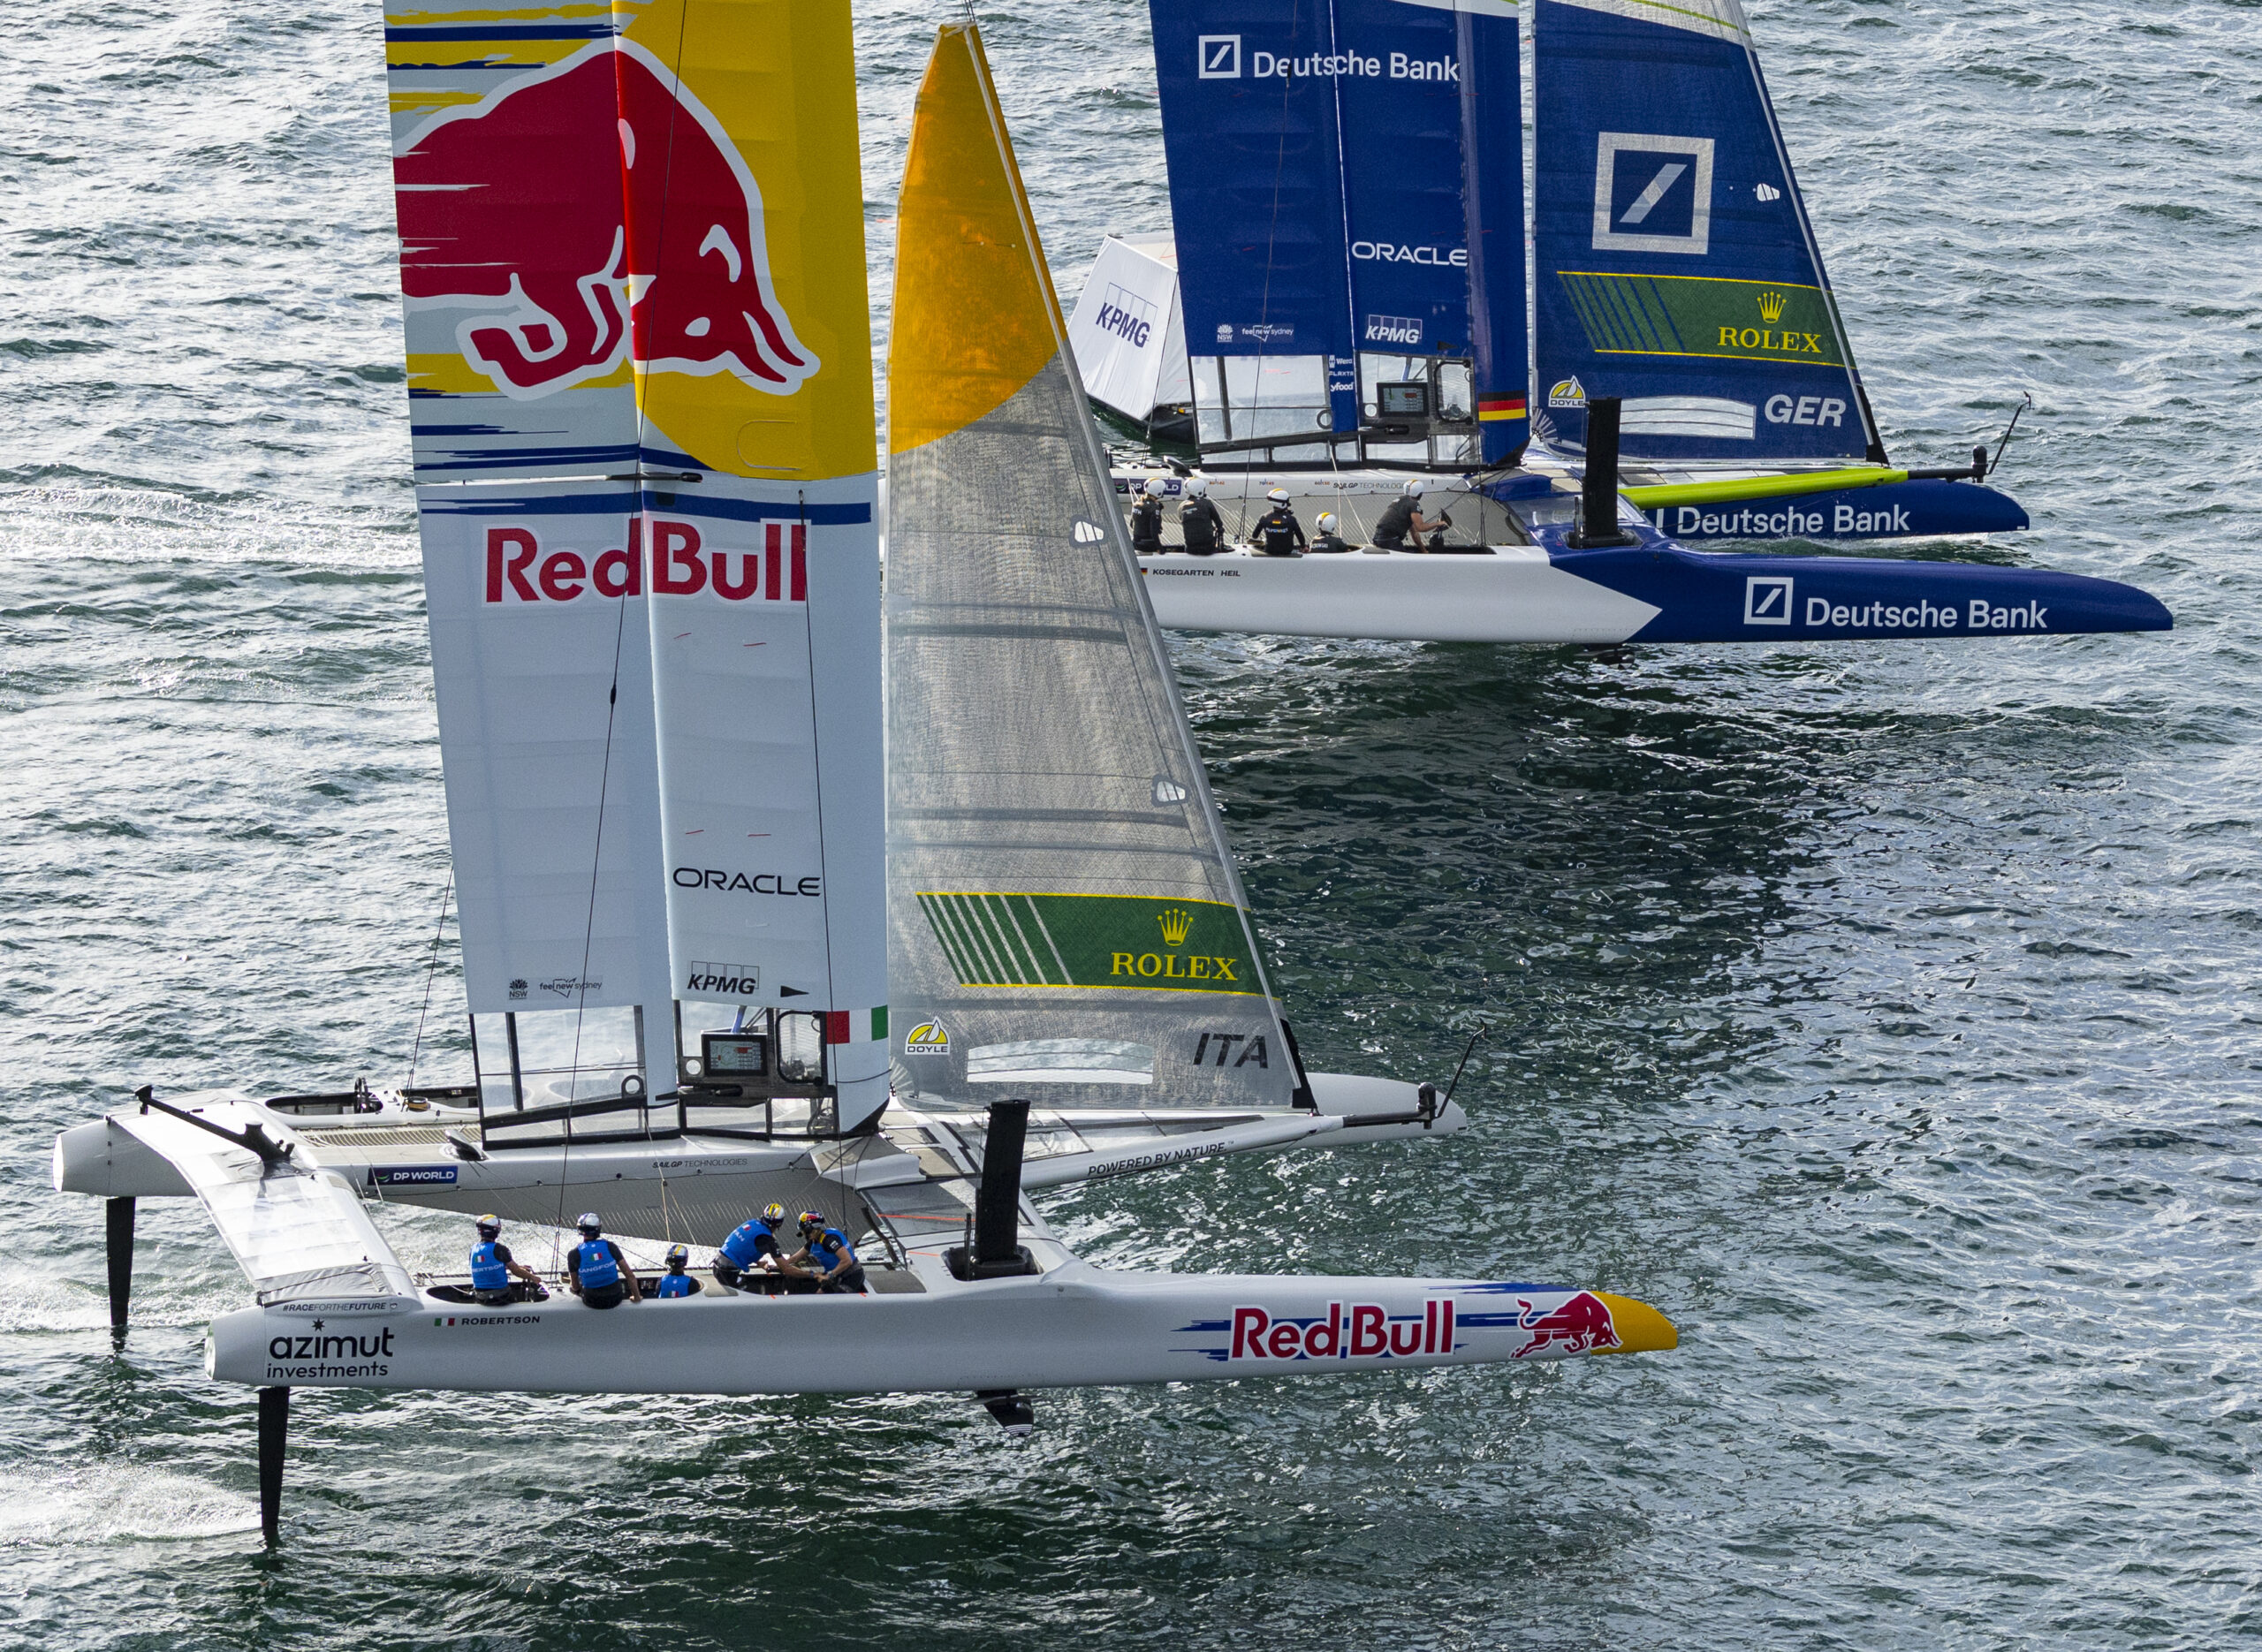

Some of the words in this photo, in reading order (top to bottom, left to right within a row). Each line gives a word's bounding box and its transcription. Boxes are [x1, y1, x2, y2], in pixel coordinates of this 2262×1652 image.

[1254, 49, 1381, 79] Deutsche
[1390, 52, 1462, 82] Bank
[1351, 241, 1469, 267] ORACLE
[1096, 302, 1150, 348] KPMG
[1365, 325, 1421, 345] KPMG
[1717, 325, 1823, 354] ROLEX
[1330, 382, 1354, 392] yfood
[1765, 393, 1847, 428] GER
[1677, 506, 1824, 534] Deutsche
[1833, 504, 1910, 533] Bank
[1152, 568, 1215, 577] KOSEGARTEN
[1806, 597, 1957, 628] Deutsche
[1969, 598, 2048, 630] Bank
[672, 867, 822, 897] ORACLE
[1110, 951, 1238, 981] ROLEX
[574, 981, 603, 990] sydney
[687, 974, 757, 995] KPMG
[907, 1045, 949, 1054] DOYLE
[1193, 1033, 1270, 1069] ITA
[684, 1158, 748, 1167] TECHNOLOGIES
[1087, 1156, 1152, 1177] POWERED
[1153, 1151, 1173, 1164] BY
[392, 1171, 410, 1181] DP
[411, 1171, 455, 1180] WORLD
[283, 1302, 387, 1313] #RACEFORTHEFUTURE
[461, 1315, 541, 1326] ROBERTSON
[269, 1322, 395, 1360] azimut
[267, 1360, 389, 1378] investments
